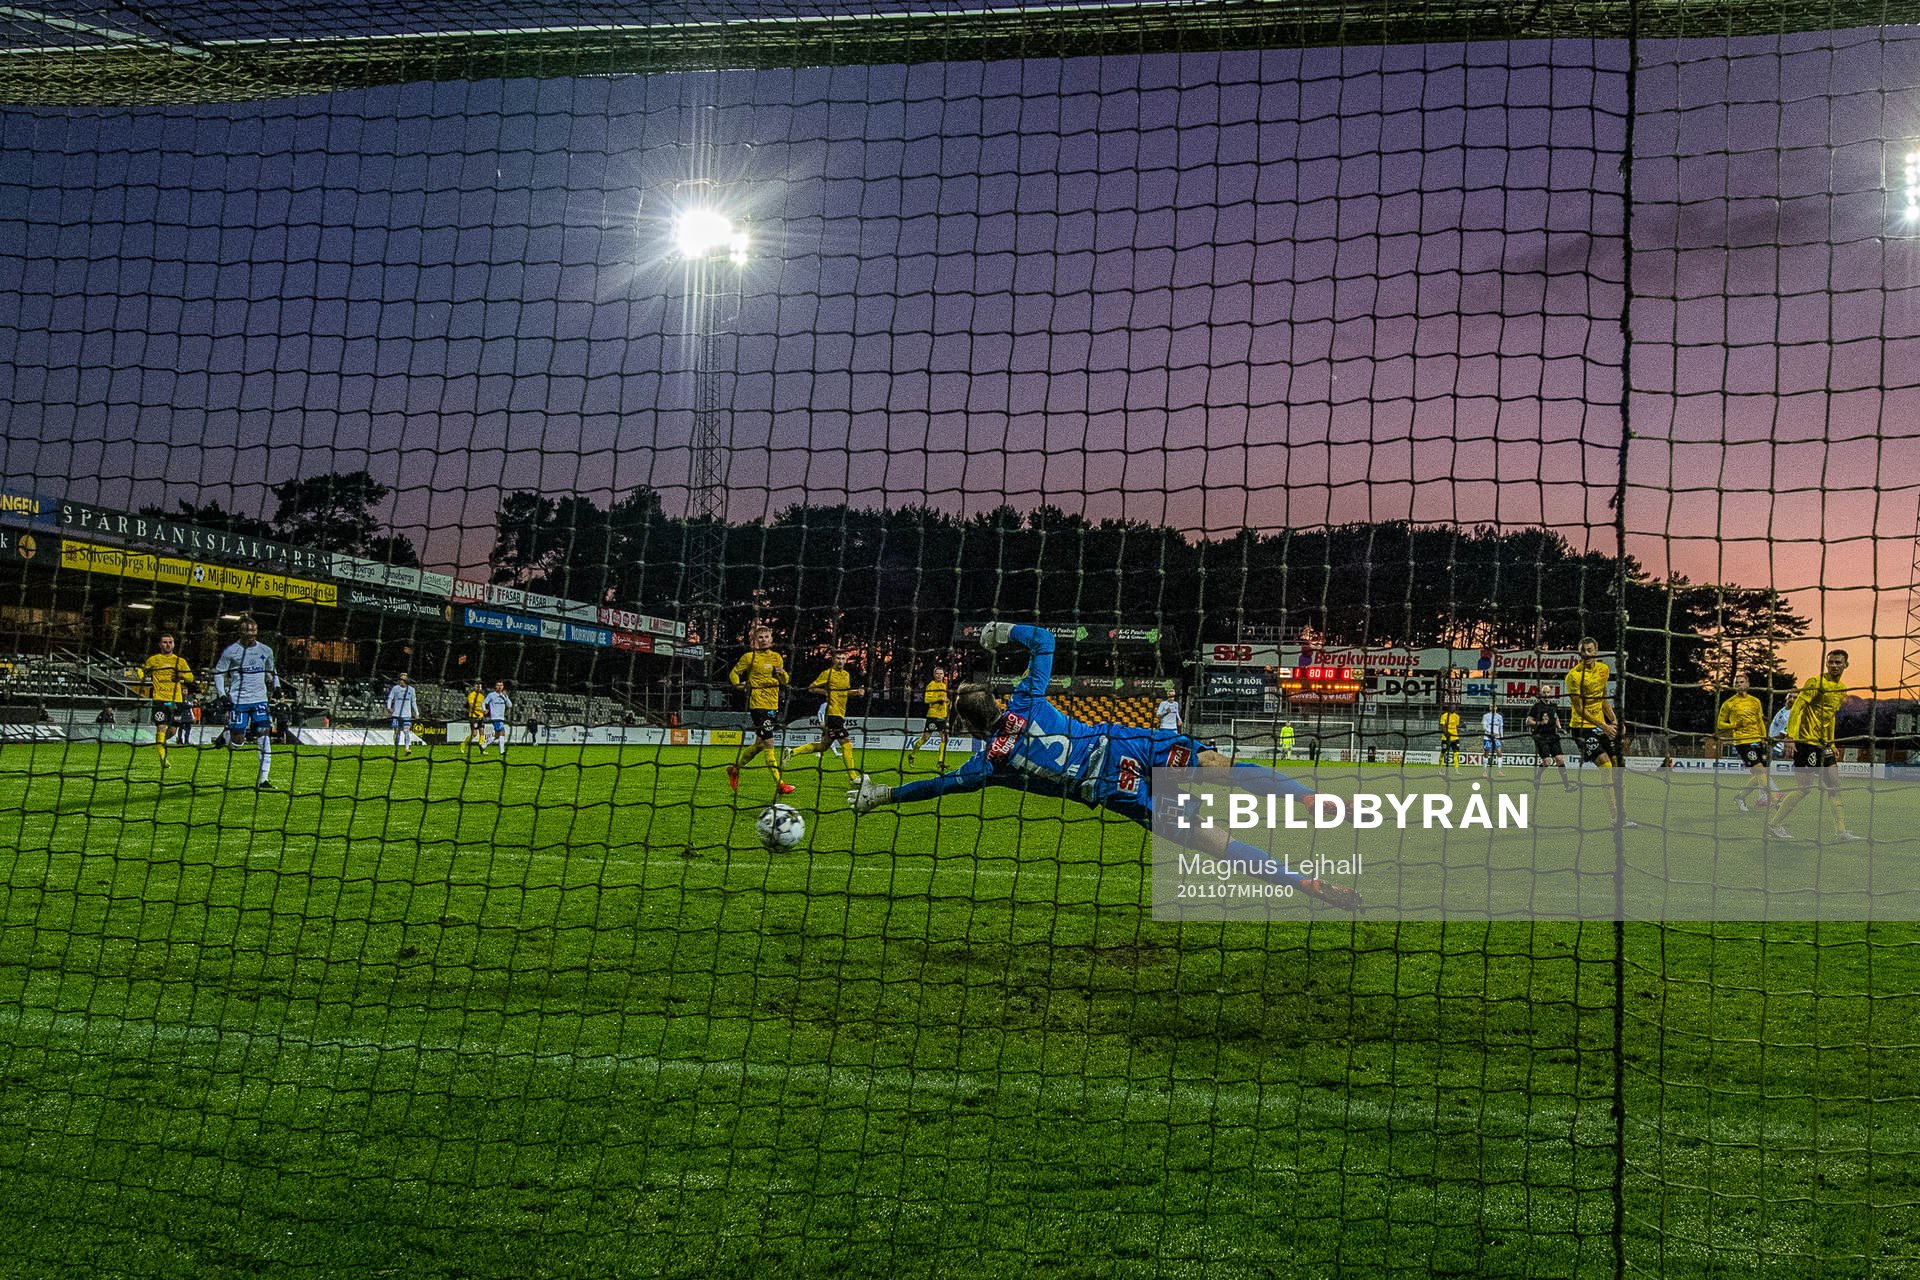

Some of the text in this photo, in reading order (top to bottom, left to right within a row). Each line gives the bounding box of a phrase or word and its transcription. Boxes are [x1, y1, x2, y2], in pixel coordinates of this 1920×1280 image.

[455, 580, 485, 601] SAVE
[1313, 649, 1420, 668] Bergkvarabuss
[1494, 652, 1594, 673] Bergkvarab
[1466, 684, 1498, 697] BLT
[1506, 682, 1561, 699] MAI
